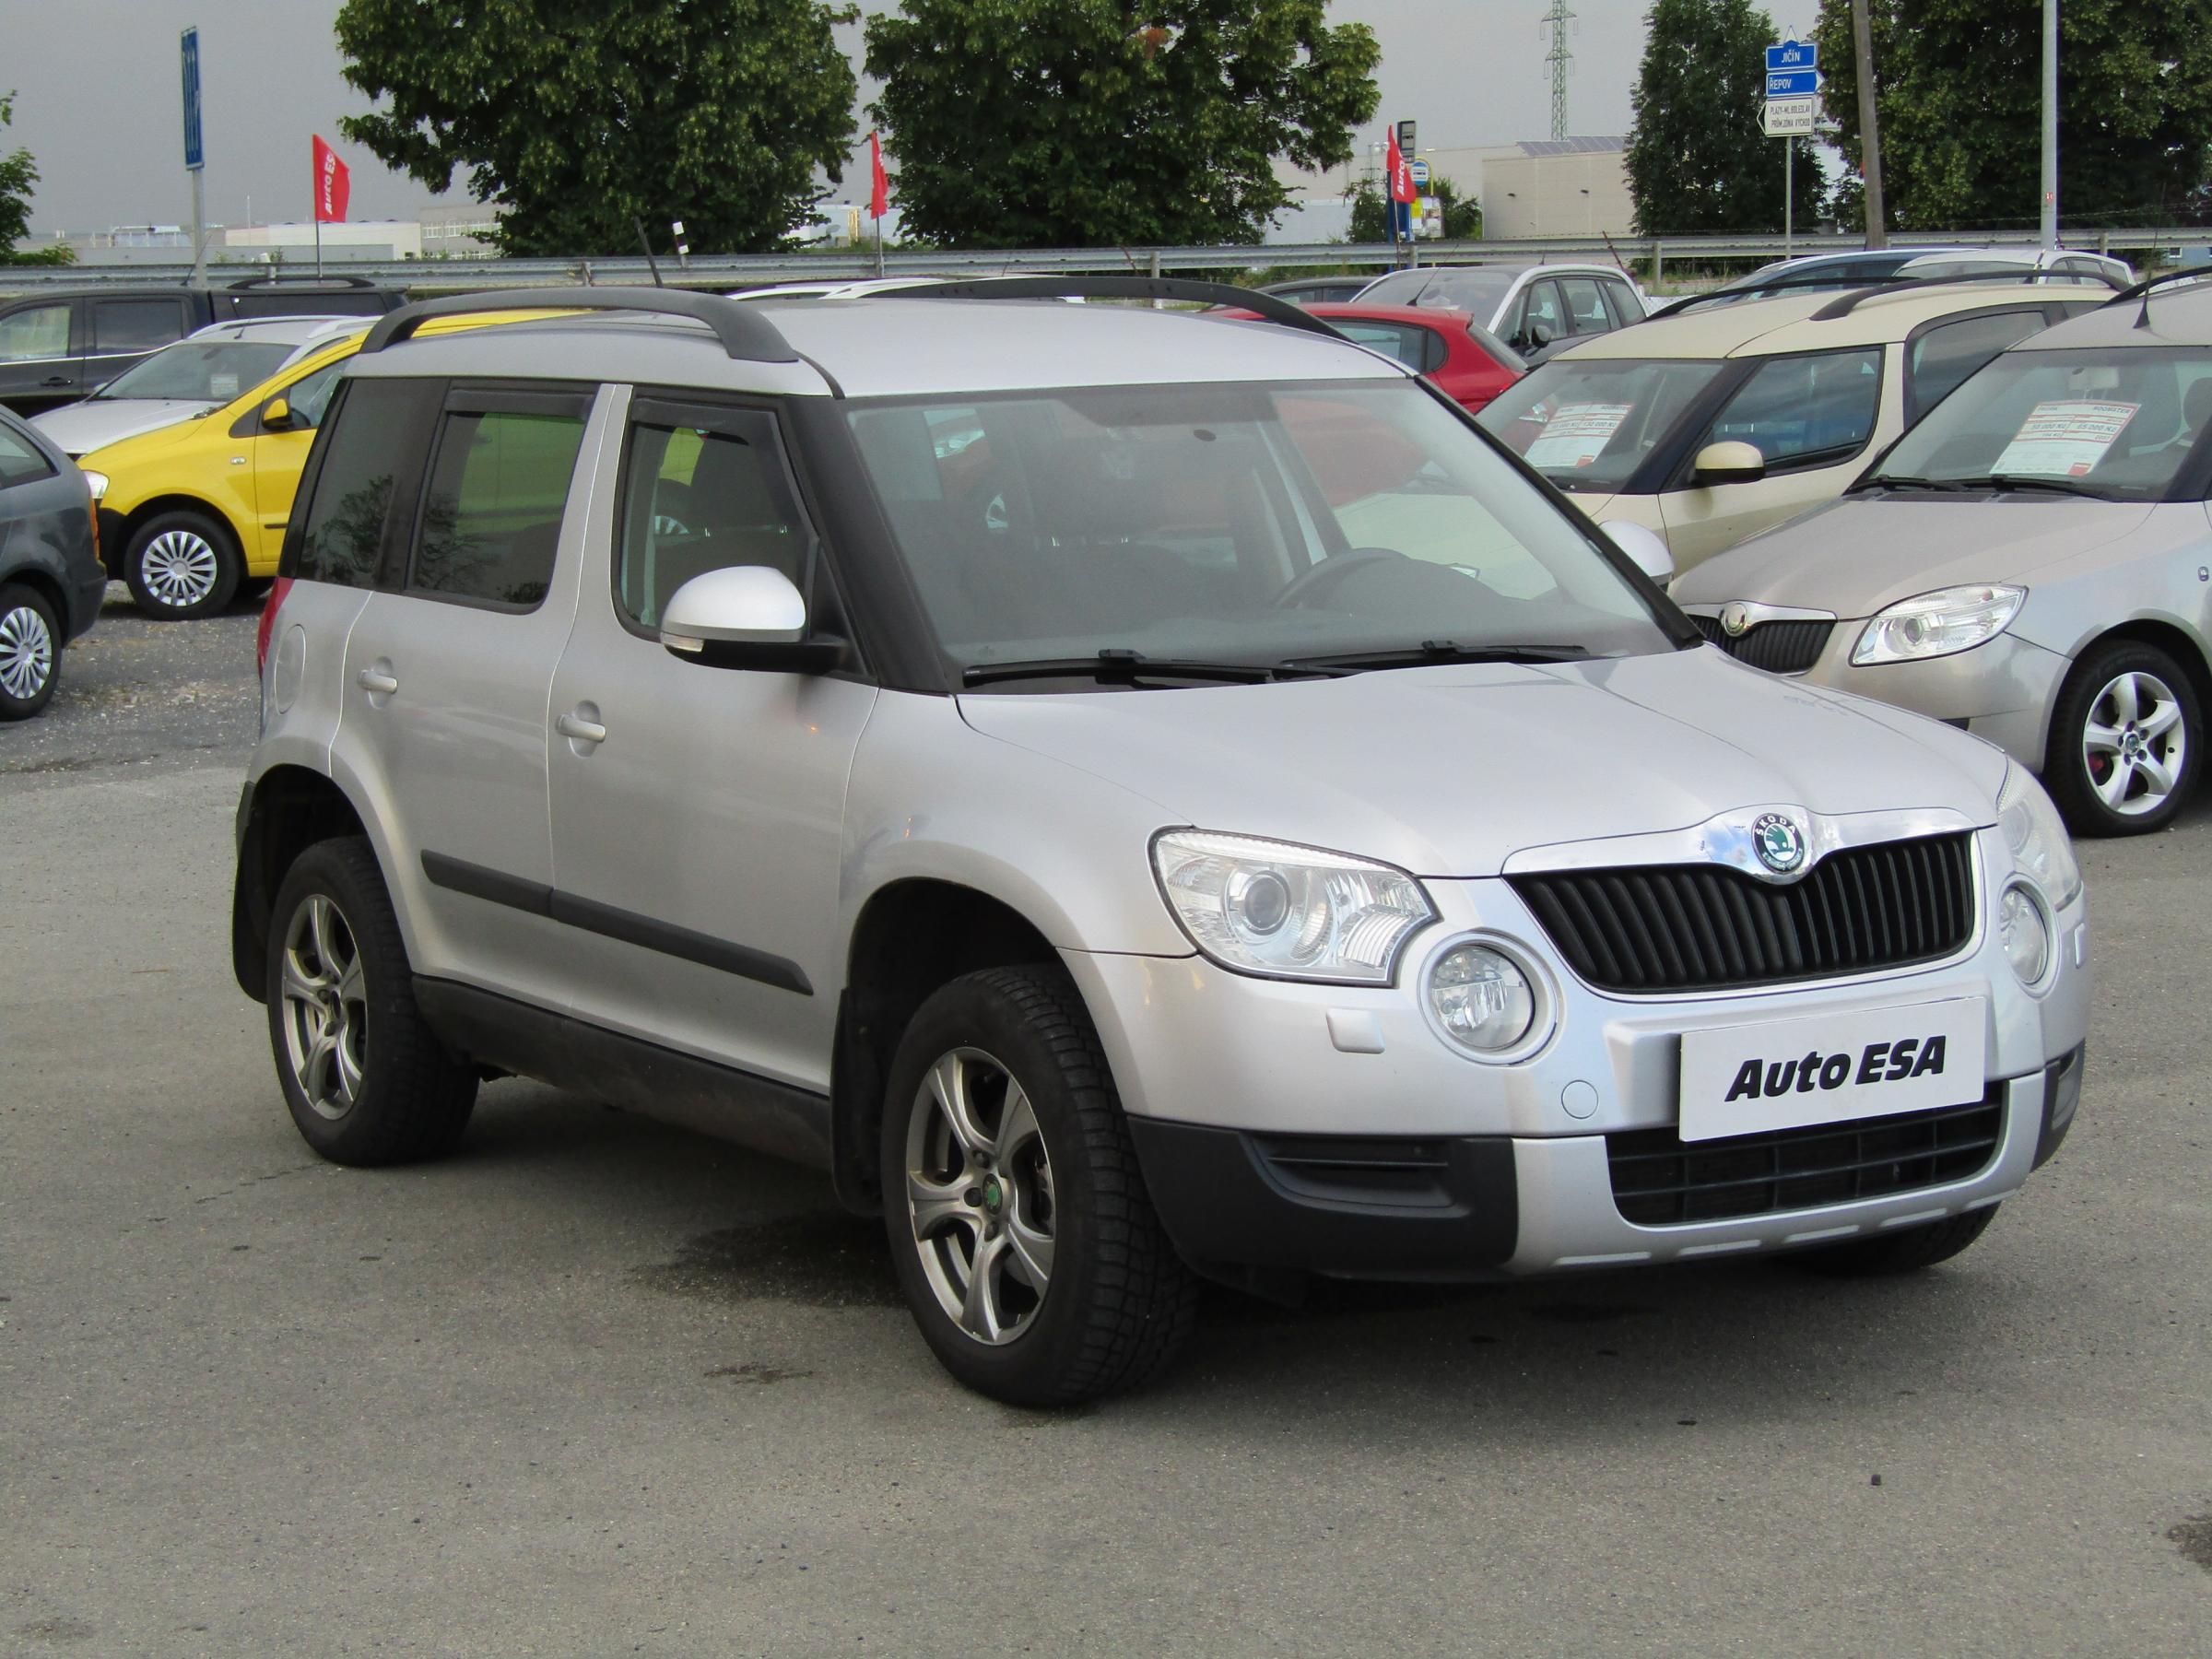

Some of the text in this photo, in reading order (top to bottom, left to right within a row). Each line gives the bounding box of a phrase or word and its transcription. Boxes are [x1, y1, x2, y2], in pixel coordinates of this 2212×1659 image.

[1782, 49, 1800, 63] JIČÍN
[1770, 77, 1792, 90] ŘEPOV
[324, 174, 333, 215] Auto
[1397, 161, 1406, 195] Auto
[1724, 1035, 1946, 1101] Auto ESA
